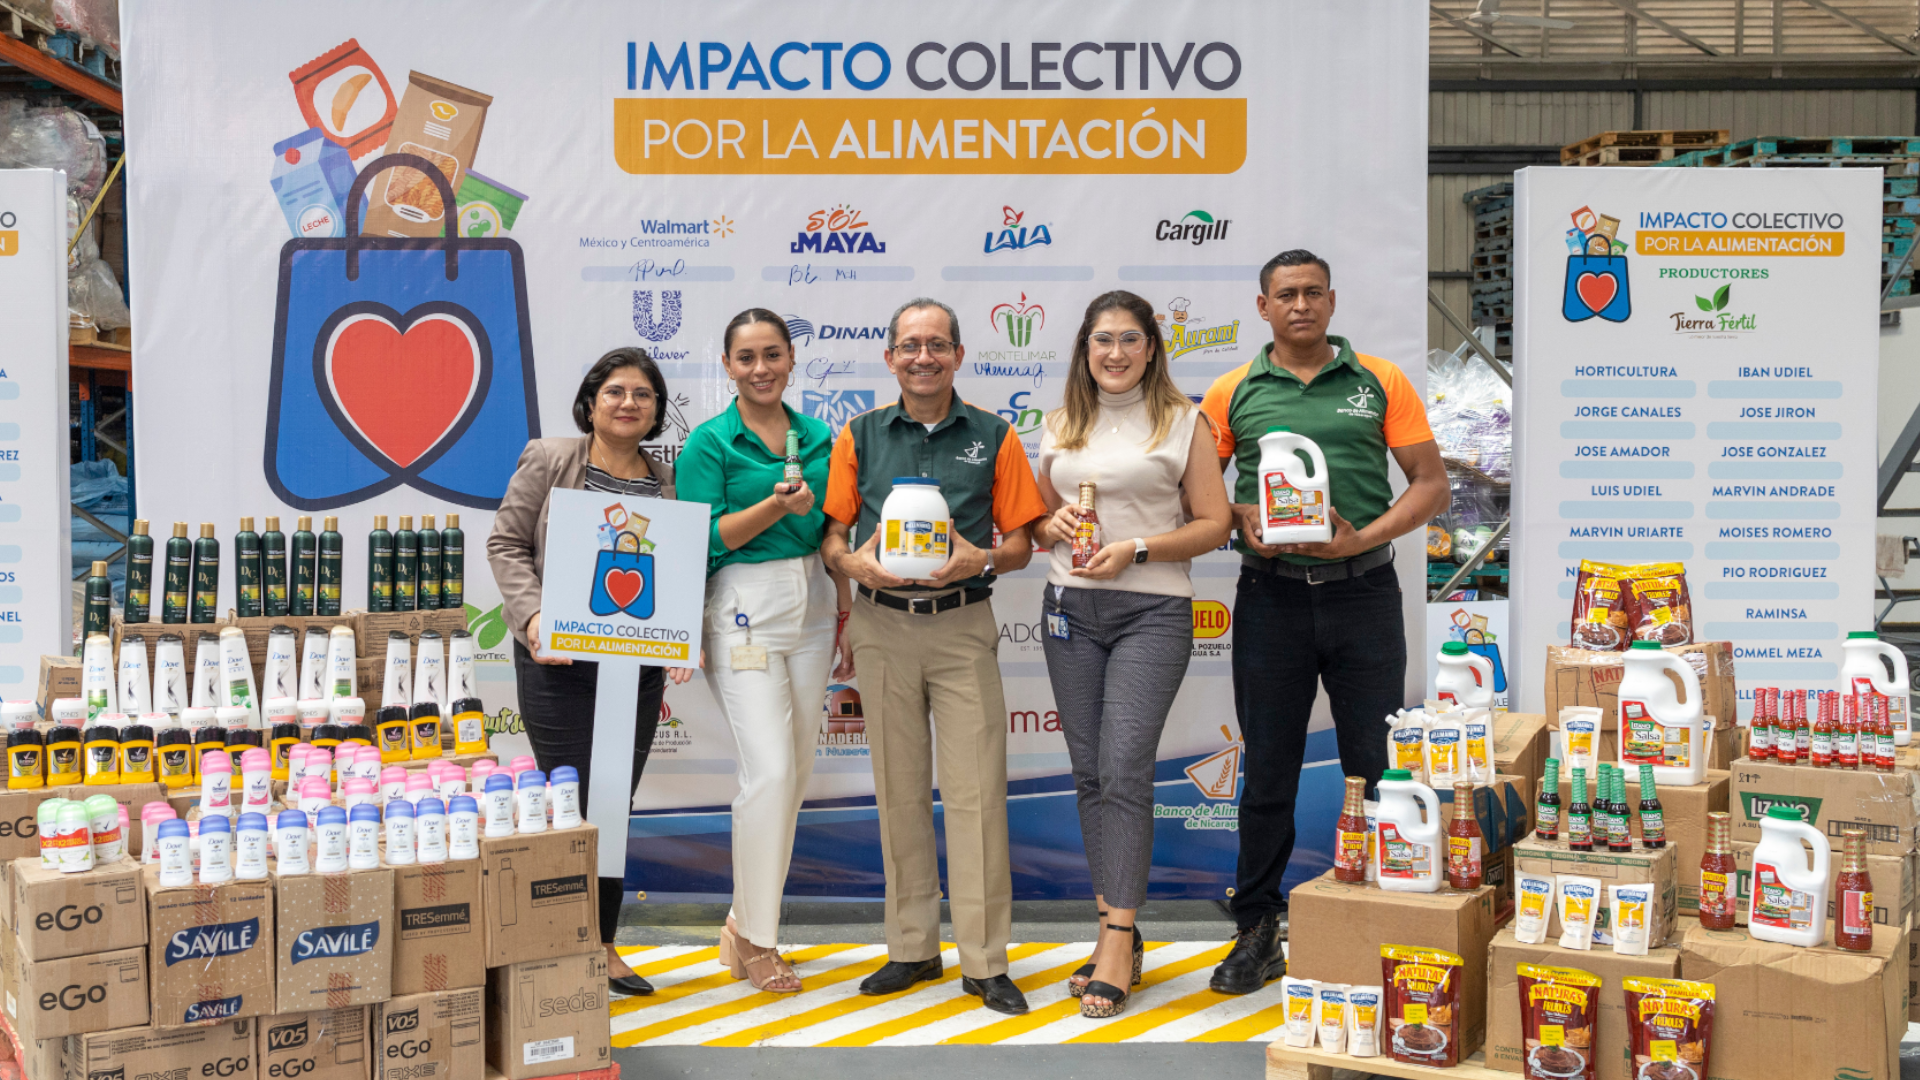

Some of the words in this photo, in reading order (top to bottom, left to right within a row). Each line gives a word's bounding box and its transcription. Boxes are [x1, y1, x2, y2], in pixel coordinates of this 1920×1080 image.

[626, 41, 892, 91] IMPACTO
[906, 41, 1243, 91] COLECTIVO
[644, 118, 746, 160] POR
[762, 118, 820, 160] LA
[828, 107, 1205, 160] ALIMENTACIÓN
[302, 216, 330, 232] LECHE
[641, 220, 709, 234] Walmart
[806, 210, 868, 232] SOL
[1640, 212, 1728, 229] IMPACTO
[1732, 213, 1843, 229] COLECTIVO
[983, 225, 1052, 253] LALA
[1155, 220, 1229, 245] Cargill
[580, 237, 618, 248] México
[621, 240, 626, 250] y
[630, 237, 709, 248] Centroamérica
[790, 232, 886, 253] MAYA
[1645, 237, 1681, 251] POR
[1684, 238, 1704, 251] LA
[1707, 235, 1832, 252] ALIMENTACIÓN
[1659, 269, 1769, 279] PRODUCTORES
[1670, 312, 1715, 331] Tierra
[1717, 313, 1757, 331] Fértil
[818, 324, 890, 340] DINAN
[978, 351, 1057, 361] MONTELIMAR
[1575, 366, 1677, 377] HORTICULTURA
[1739, 368, 1771, 377] IBAN
[1775, 368, 1813, 377] UDIEL
[1574, 407, 1618, 417] JORGE
[1621, 407, 1681, 418] CANALES
[1740, 408, 1772, 418] JOSE
[1776, 408, 1815, 418] JIRON
[1575, 447, 1606, 457] JOSE
[1610, 447, 1670, 457] AMADOR
[1722, 447, 1753, 457] JOSE
[1757, 447, 1826, 457] GONZALEZ
[1592, 486, 1620, 496] LUIS
[1624, 486, 1661, 496] UDIEL
[1712, 486, 1766, 497] MARVIN
[1770, 486, 1835, 497] ANDRADE
[1570, 527, 1623, 538] MARVIN
[1628, 527, 1683, 538] URIARTE
[1719, 528, 1769, 538] MOISES
[1773, 528, 1831, 538] ROMERO
[1723, 567, 1746, 578] PIO
[1750, 567, 1827, 578] RODRIGUEZ
[1746, 609, 1807, 619] RAMINSA
[555, 620, 614, 636] IMPACTO
[616, 625, 689, 641] COLECTIVO
[557, 637, 580, 649] POR
[583, 640, 597, 650] LA
[598, 640, 682, 657] ALIMENTACIÓN
[1787, 648, 1822, 658] MEZA
[203, 659, 219, 667] Dove
[273, 652, 290, 660] Dove
[819, 733, 869, 744] NADERÍ
[1635, 732, 1660, 740] Salsa
[1155, 805, 1193, 817] Banco
[1195, 805, 1210, 816] de
[1187, 820, 1198, 828] de
[534, 880, 583, 895] TRESemmé
[1766, 895, 1789, 905] Salsa
[36, 904, 103, 931] eGo
[405, 909, 466, 925] TRESemmé
[172, 926, 252, 958] SAVILÉ
[298, 928, 373, 957] SAVILÉ
[39, 984, 106, 1010] eGo
[540, 984, 602, 1017] sedal
[188, 1000, 240, 1021] SAVILÉ
[1543, 1001, 1571, 1014] FRIJOLES
[388, 1015, 418, 1030] VO5
[270, 1028, 307, 1047] VO5
[387, 1040, 431, 1058] eGo
[202, 1057, 249, 1076] eGo
[269, 1059, 315, 1078] eGo
